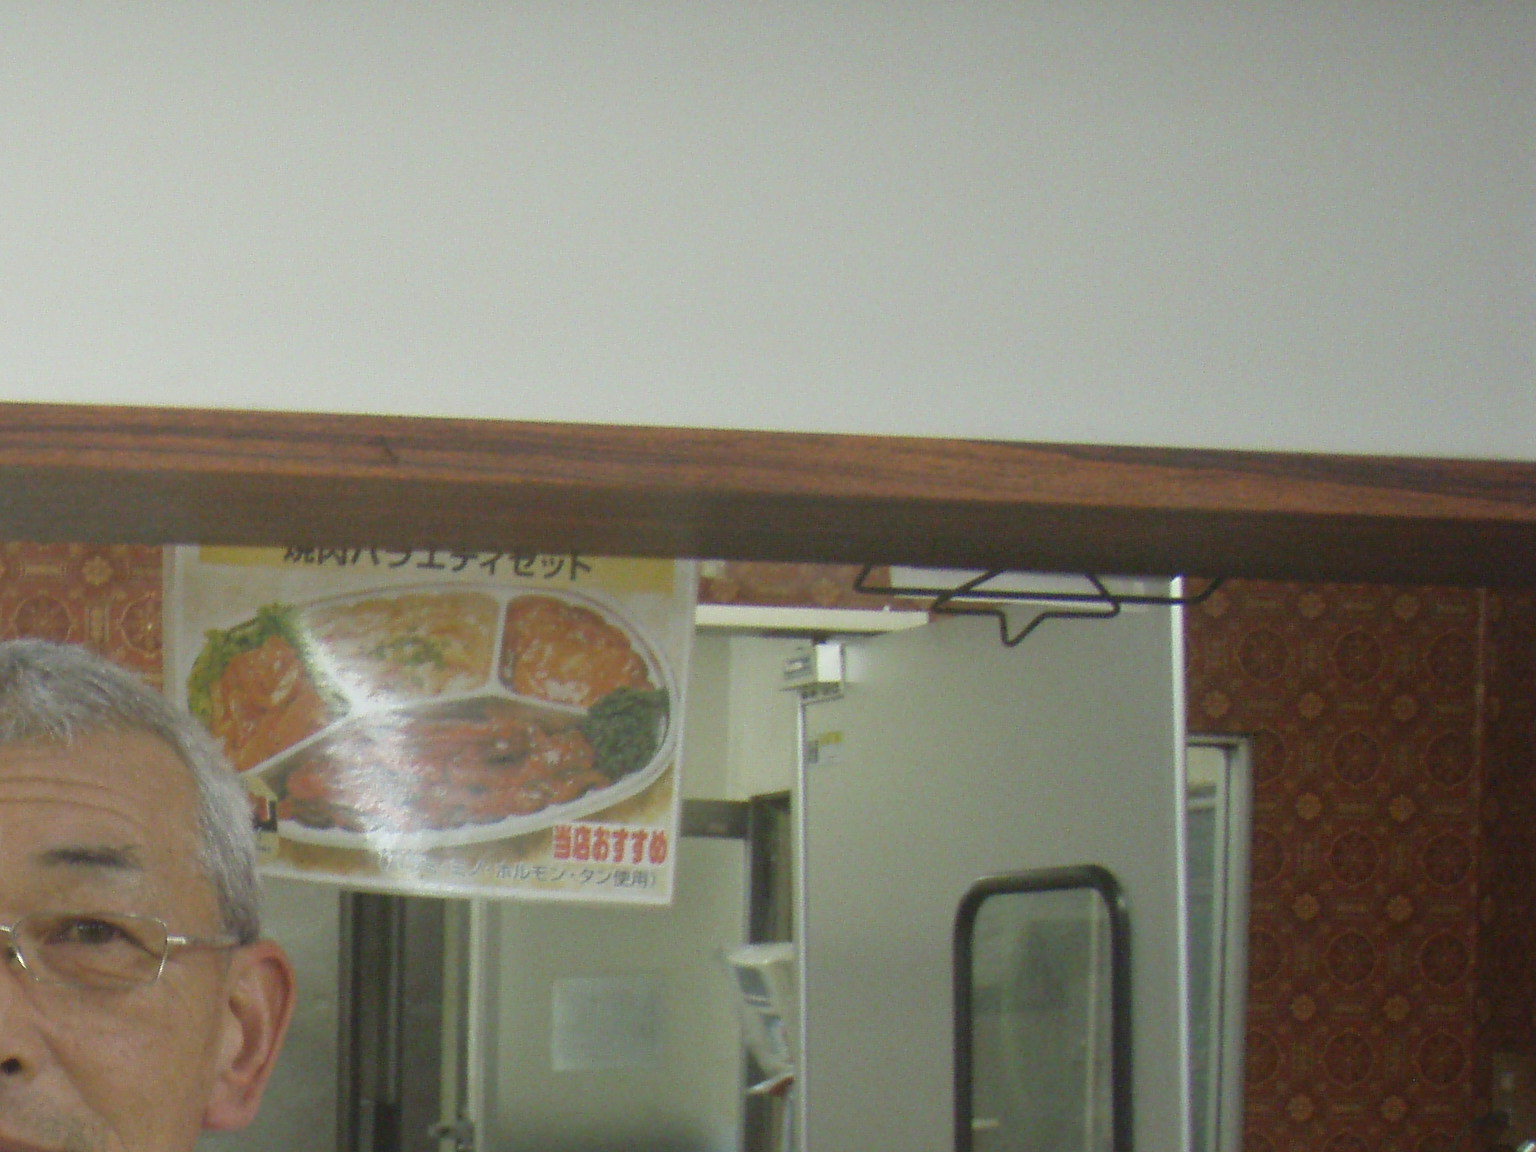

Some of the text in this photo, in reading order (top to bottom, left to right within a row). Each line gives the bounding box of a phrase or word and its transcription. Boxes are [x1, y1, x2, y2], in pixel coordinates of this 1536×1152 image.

[553, 824, 669, 865] 当店おすすめ
